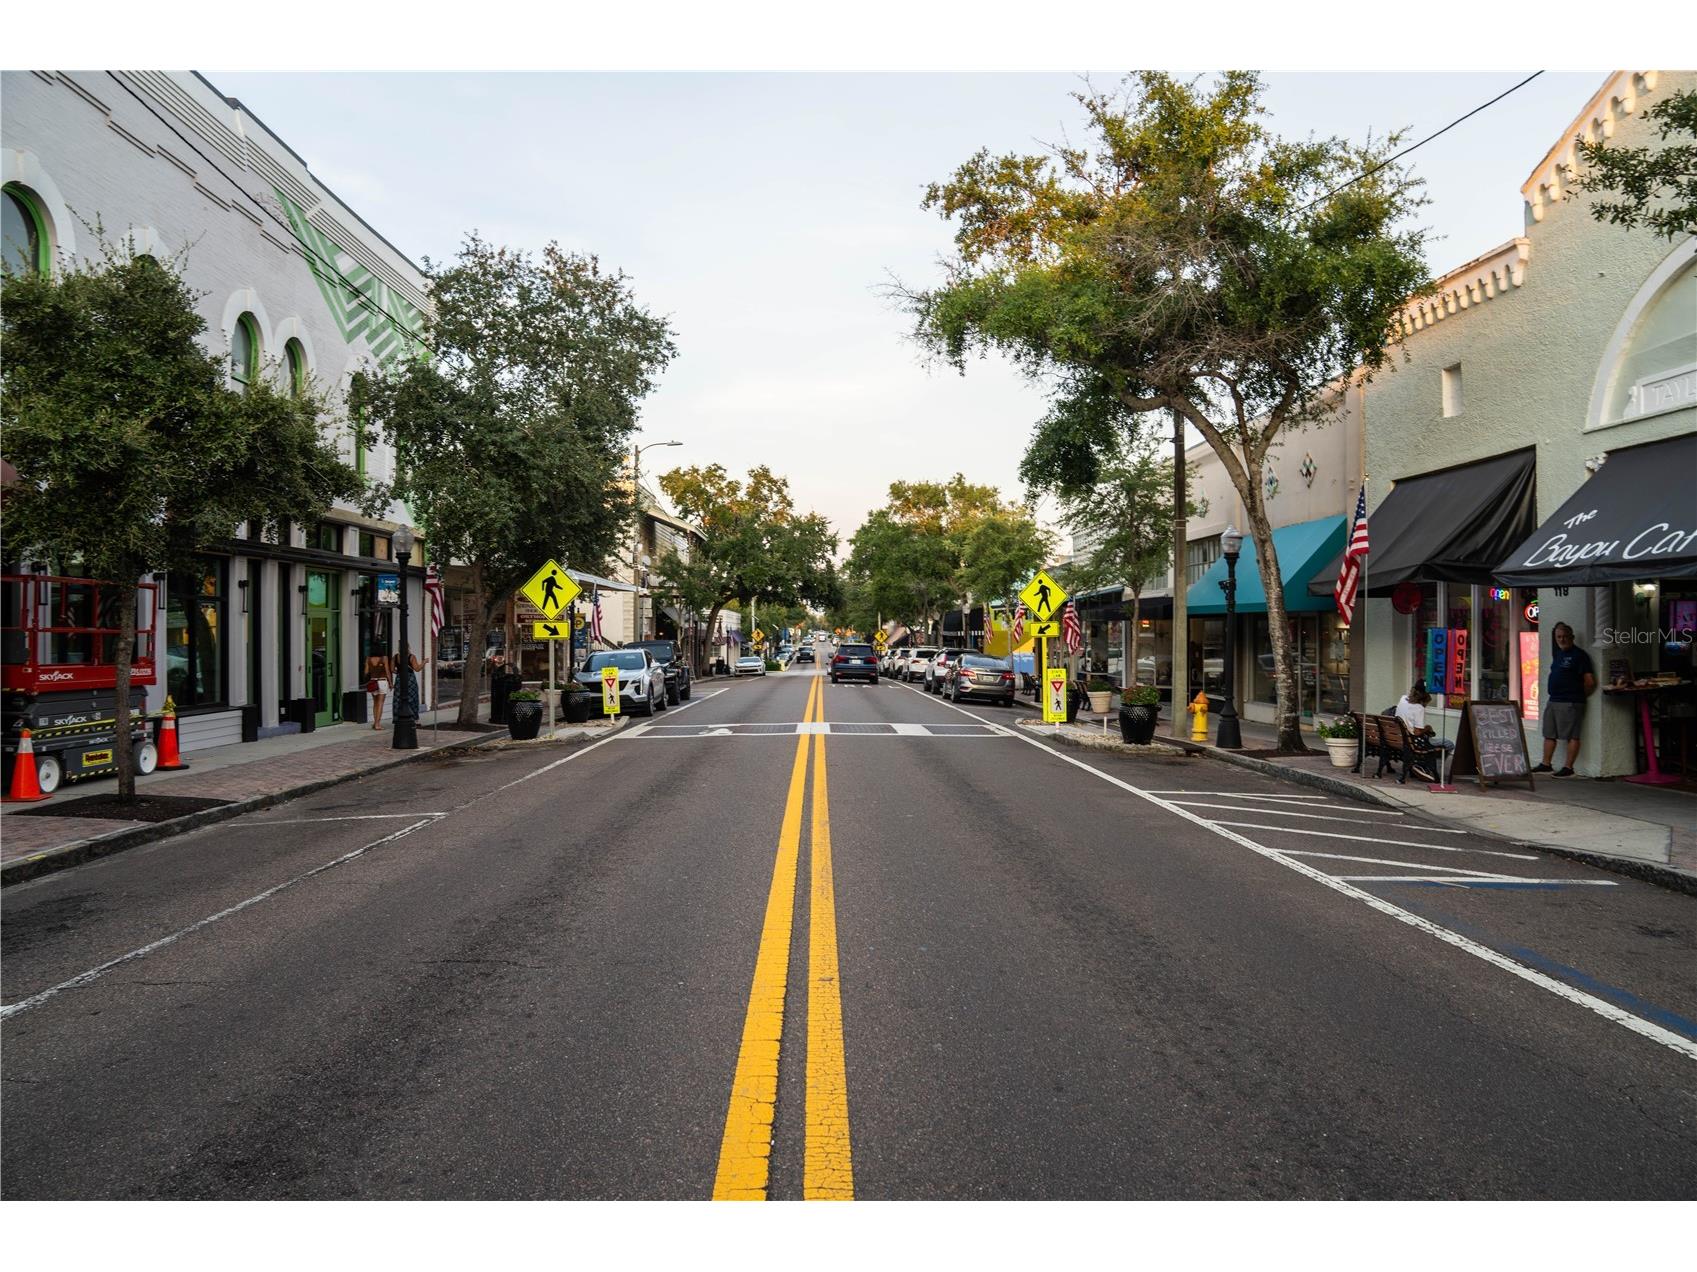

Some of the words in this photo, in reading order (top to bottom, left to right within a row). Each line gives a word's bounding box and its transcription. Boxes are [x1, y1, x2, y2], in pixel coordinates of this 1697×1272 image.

[1563, 509, 1598, 528] The
[1522, 533, 1620, 568] Bayou
[1527, 606, 1540, 618] OP
[1434, 633, 1444, 688] OPEN
[39, 671, 73, 681] SKYJACK
[54, 714, 87, 726] SKYJACK
